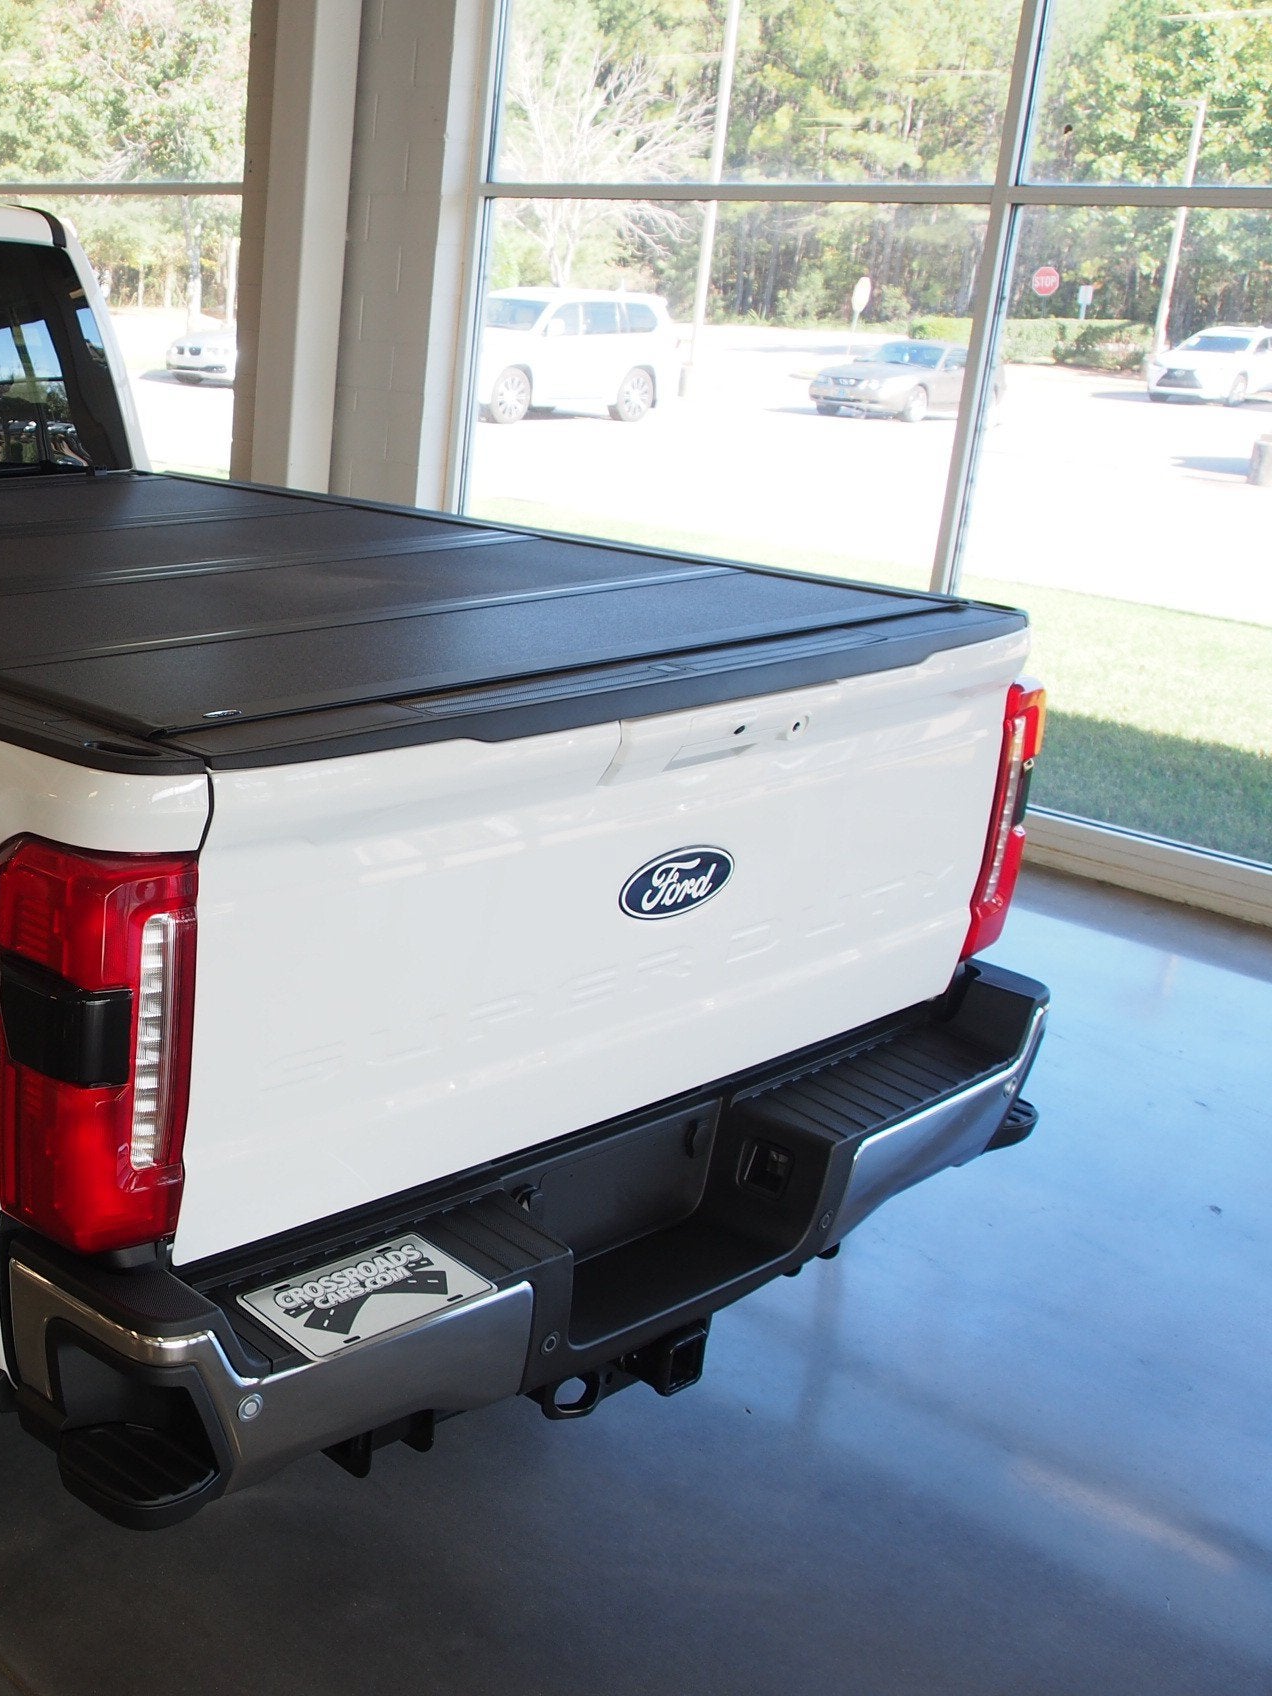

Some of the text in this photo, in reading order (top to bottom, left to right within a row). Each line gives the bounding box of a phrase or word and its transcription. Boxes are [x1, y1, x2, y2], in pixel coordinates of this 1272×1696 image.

[1034, 275, 1057, 288] STOP
[641, 857, 717, 911] Ford
[274, 1243, 425, 1310] CROSSROADS
[313, 1265, 414, 1309] CARS.COM
